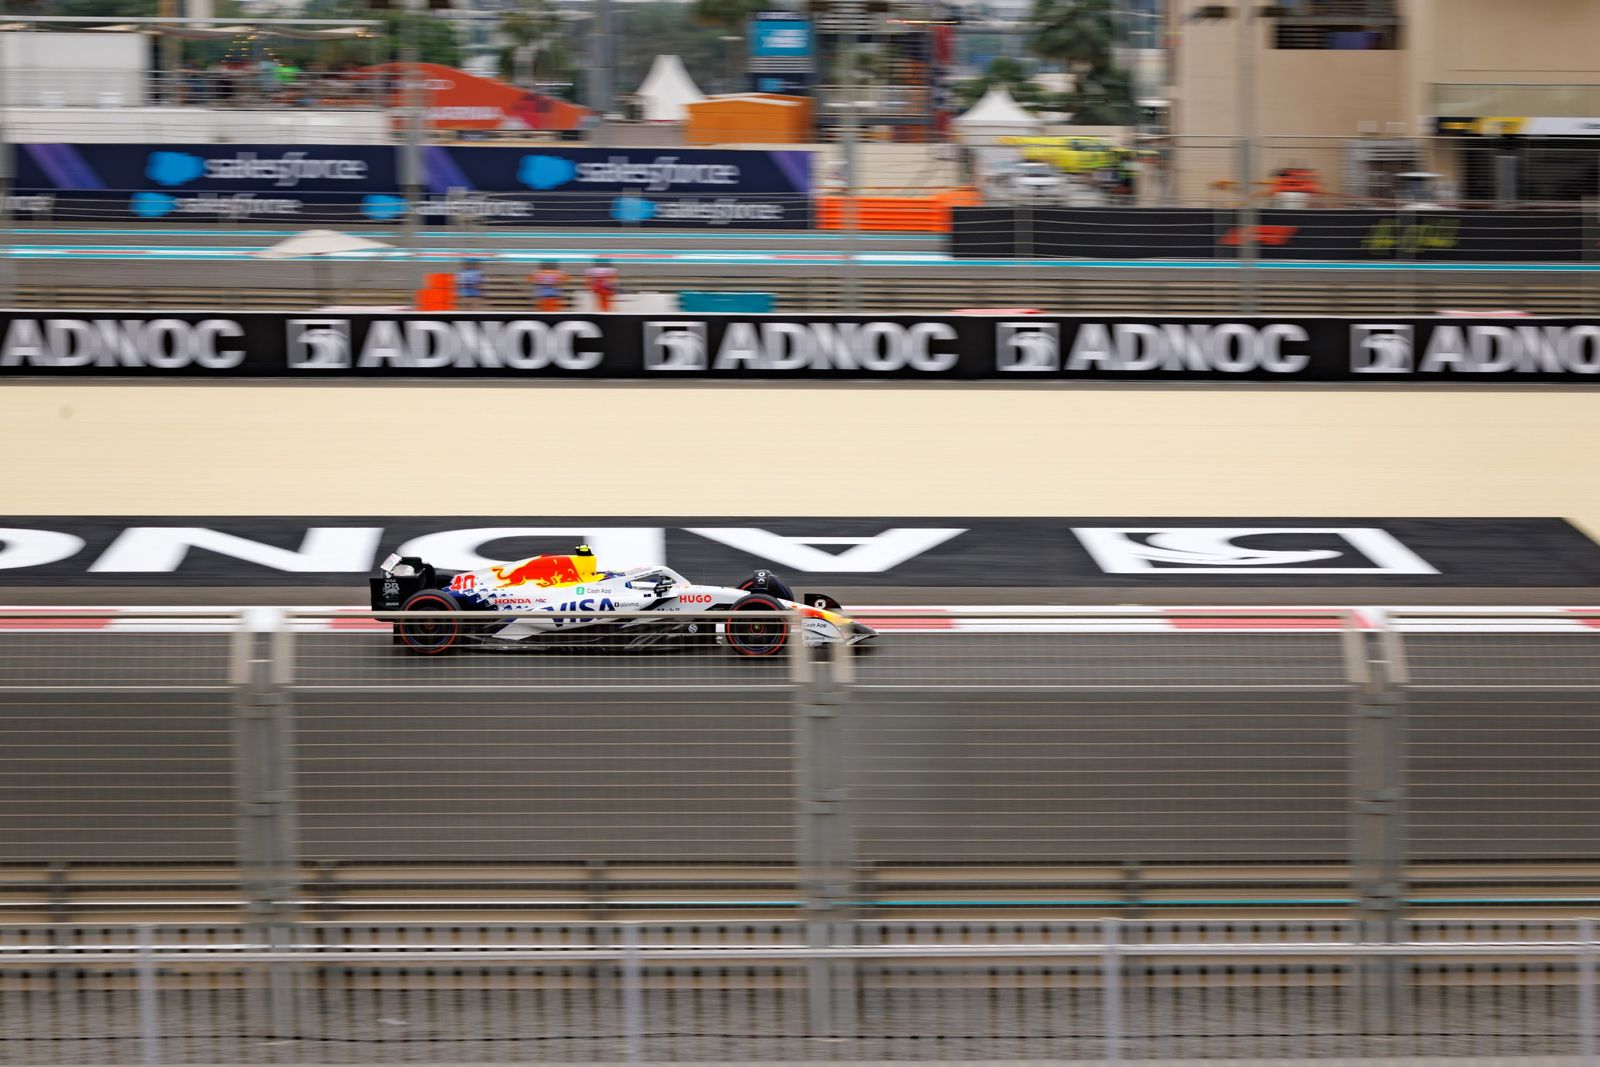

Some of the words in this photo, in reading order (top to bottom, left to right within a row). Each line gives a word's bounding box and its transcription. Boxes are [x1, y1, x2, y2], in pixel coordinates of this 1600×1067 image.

[203, 151, 367, 186] salesforce
[575, 156, 741, 191] salesforce
[4, 318, 245, 369] ADNOC
[358, 320, 604, 370] ADNOC
[713, 321, 959, 371] ADNOC
[1065, 322, 1310, 372] ADNOC
[540, 598, 616, 627] VISA
[679, 594, 712, 603] HUGO
